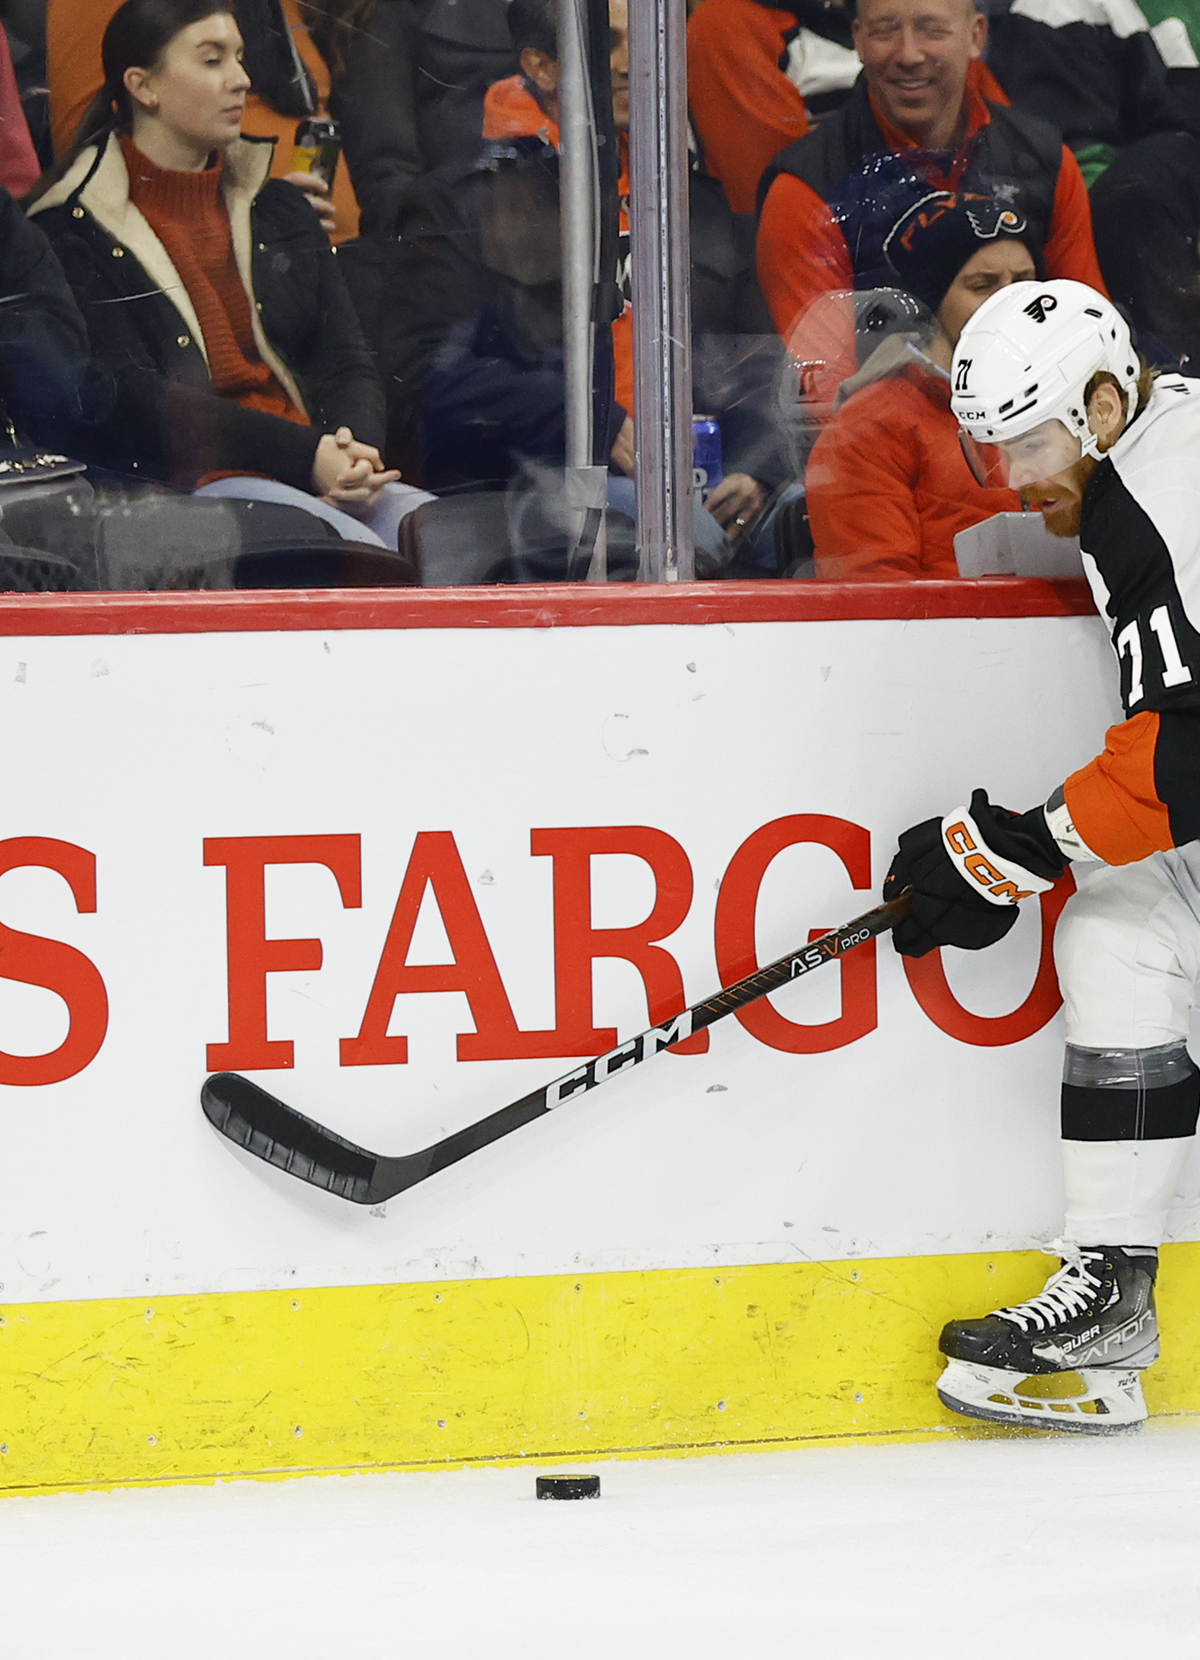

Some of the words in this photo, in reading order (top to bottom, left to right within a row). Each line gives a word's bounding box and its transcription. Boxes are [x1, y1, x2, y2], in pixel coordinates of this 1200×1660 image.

[955, 359, 973, 391] 71
[958, 411, 986, 420] CCM
[1117, 604, 1193, 708] 71
[945, 821, 1037, 903] CCM
[840, 927, 870, 951] PRO
[545, 1009, 693, 1110] CCM
